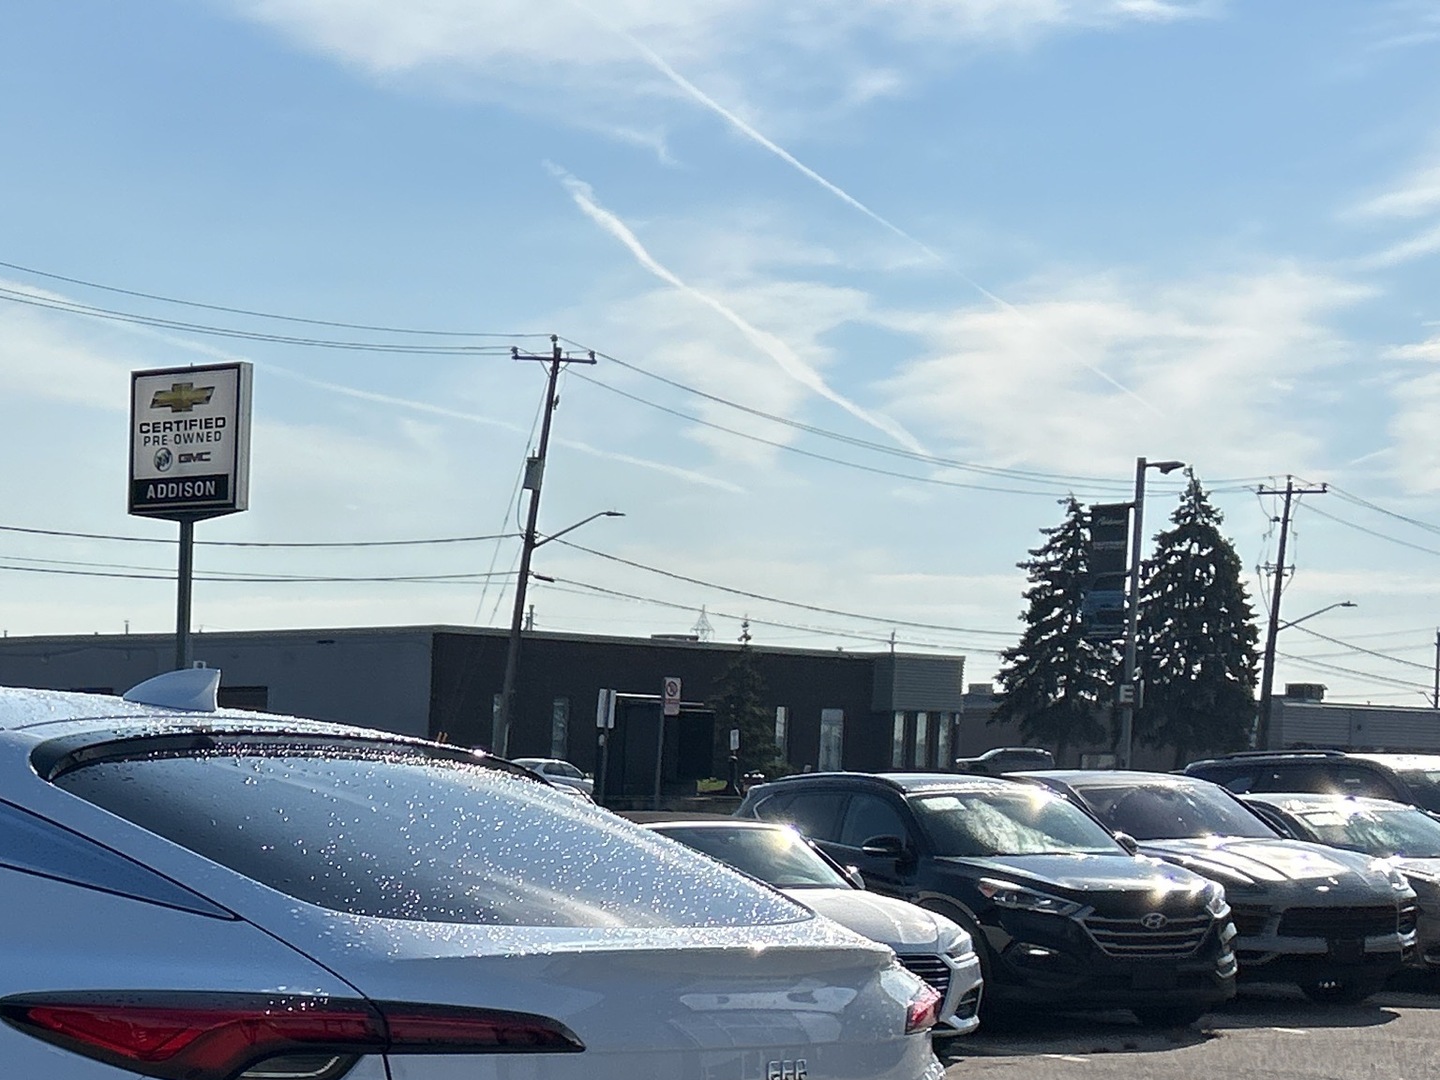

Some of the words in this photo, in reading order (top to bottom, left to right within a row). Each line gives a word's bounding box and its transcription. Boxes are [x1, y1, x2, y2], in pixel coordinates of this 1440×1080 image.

[139, 417, 226, 434] CERTIFIED
[143, 431, 222, 447] PRE-OWNED
[178, 452, 211, 464] GMC
[146, 480, 216, 499] ADDISON
[1120, 684, 1134, 703] E
